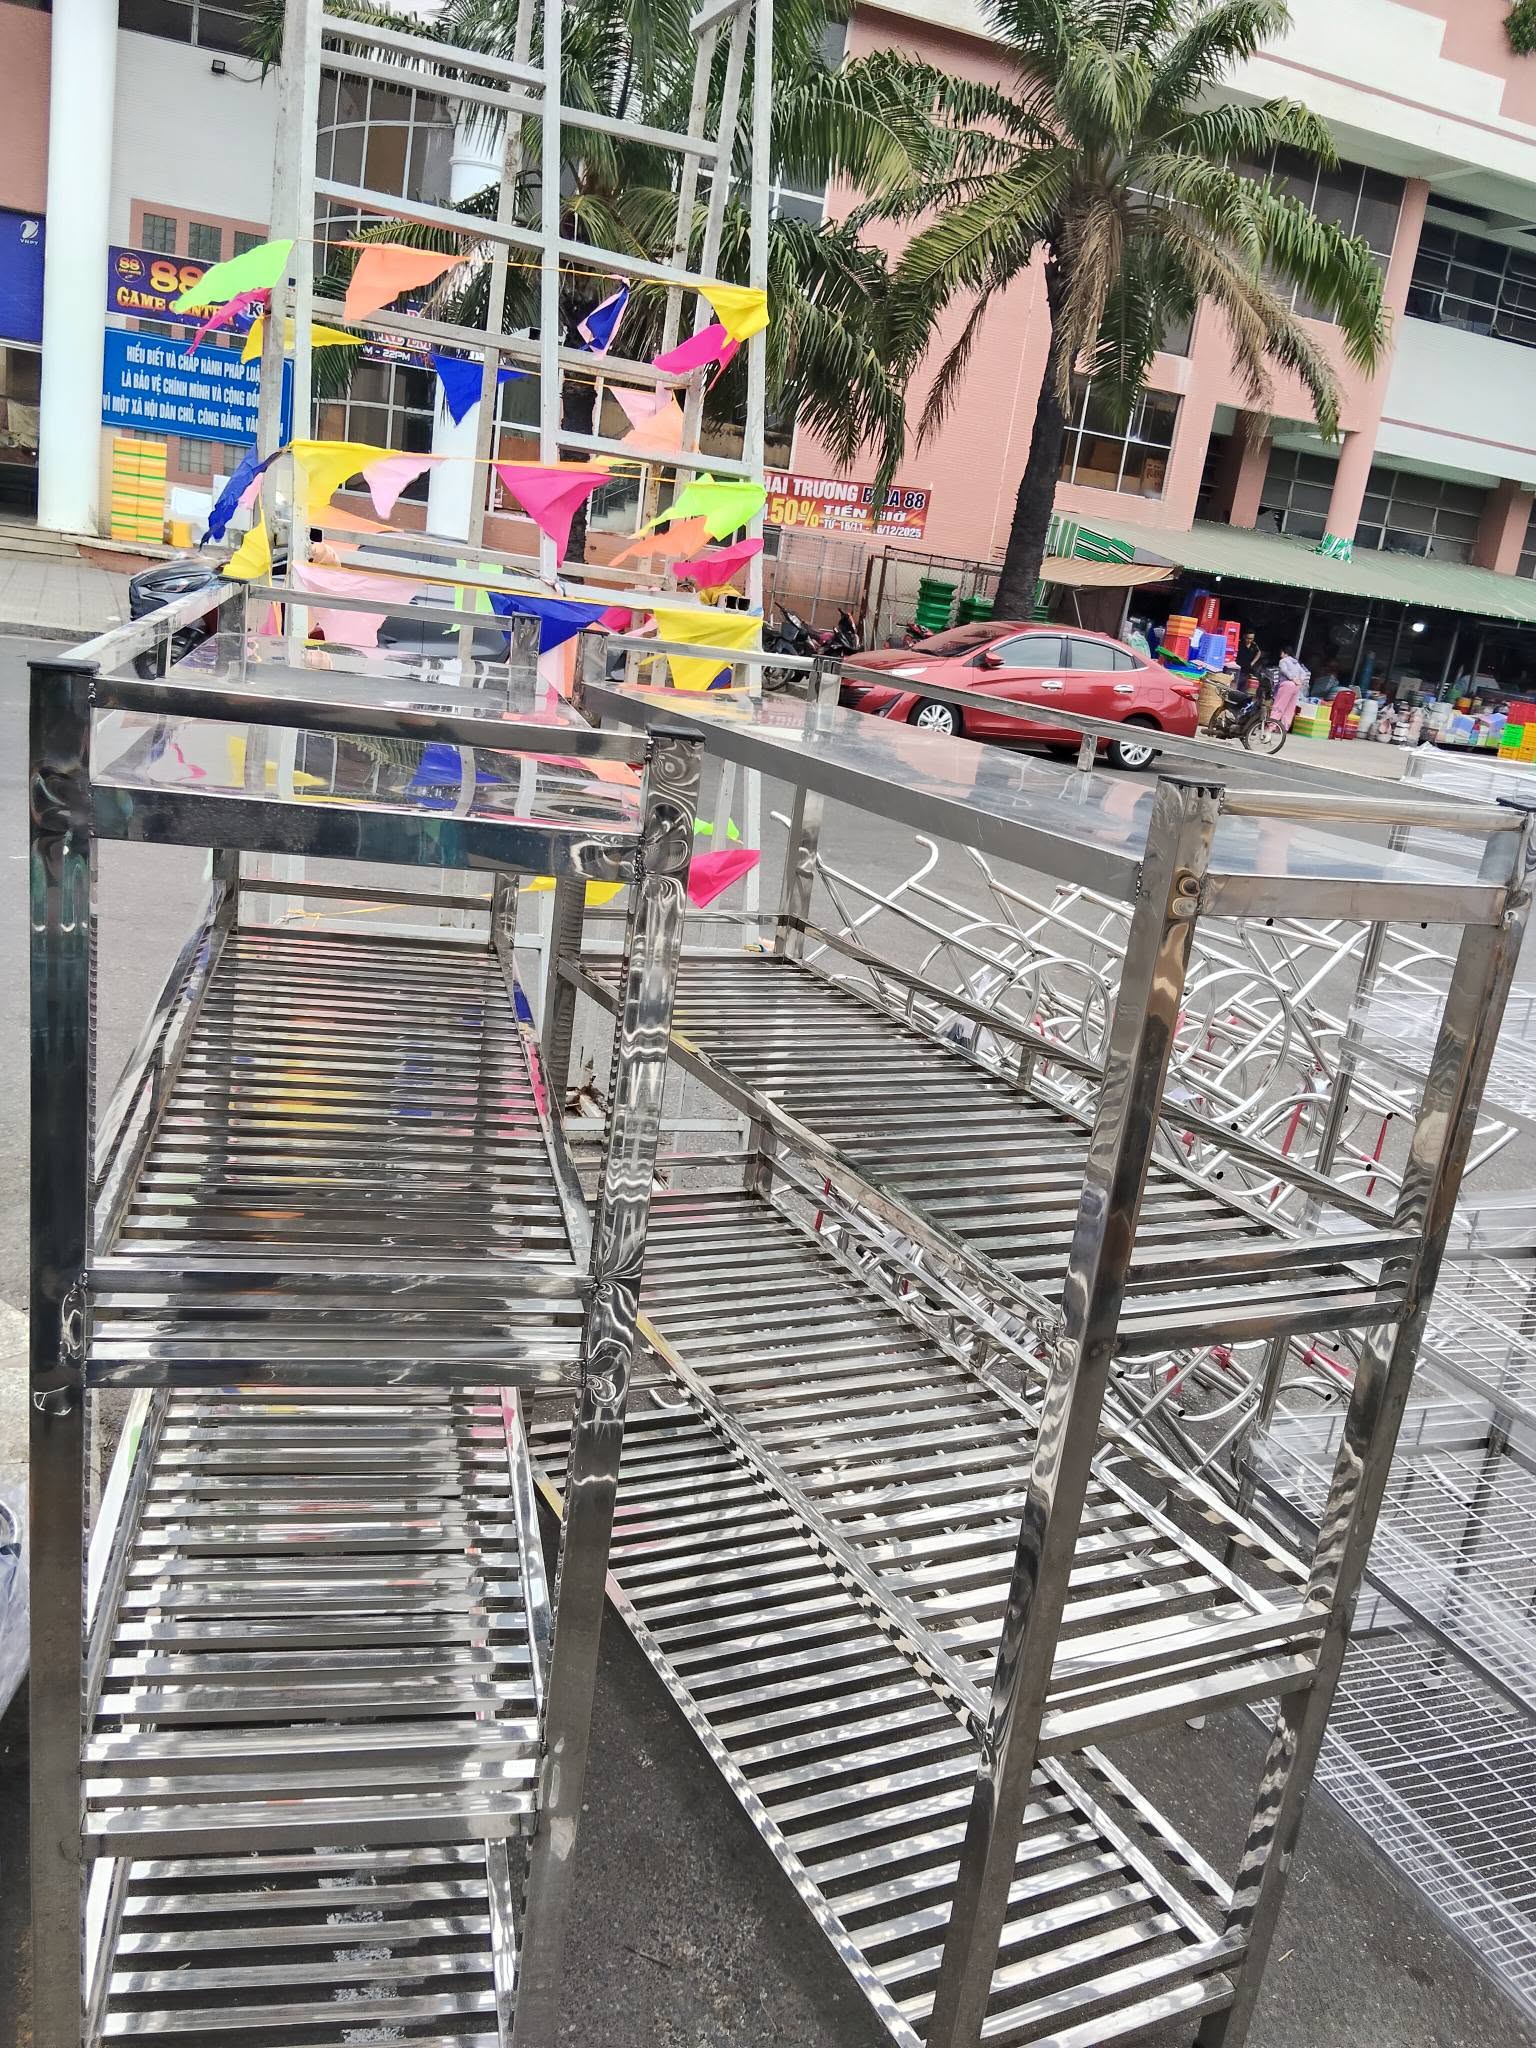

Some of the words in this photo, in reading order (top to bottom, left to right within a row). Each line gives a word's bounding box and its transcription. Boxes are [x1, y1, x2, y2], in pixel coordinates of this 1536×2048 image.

[119, 256, 140, 271] 88
[116, 286, 166, 312] GAME
[126, 341, 146, 364] HIỂU
[146, 346, 165, 367] BIẾT
[165, 350, 176, 369] VÀ
[177, 351, 200, 373] CHẤP
[200, 357, 222, 377] HÀNH
[223, 360, 245, 380] PHÁP
[245, 365, 260, 386] LUẬ
[382, 348, 411, 361] 22PM
[121, 369, 132, 388] LÀ
[133, 369, 150, 391] BẢO
[151, 374, 162, 396] VỆ
[163, 377, 188, 397] CHÍNH
[188, 381, 210, 401] MÌNH
[211, 384, 222, 403] VÀ
[223, 387, 245, 408] CỘNG
[103, 391, 111, 411] VÌ
[112, 394, 130, 416] MỘT
[131, 397, 143, 416] XÃ
[144, 398, 158, 421] HỘI
[160, 402, 177, 420] DÂN
[197, 408, 219, 427] CÔNG
[763, 475, 789, 495] HAI
[903, 491, 926, 510] 88
[770, 497, 820, 528] 50%
